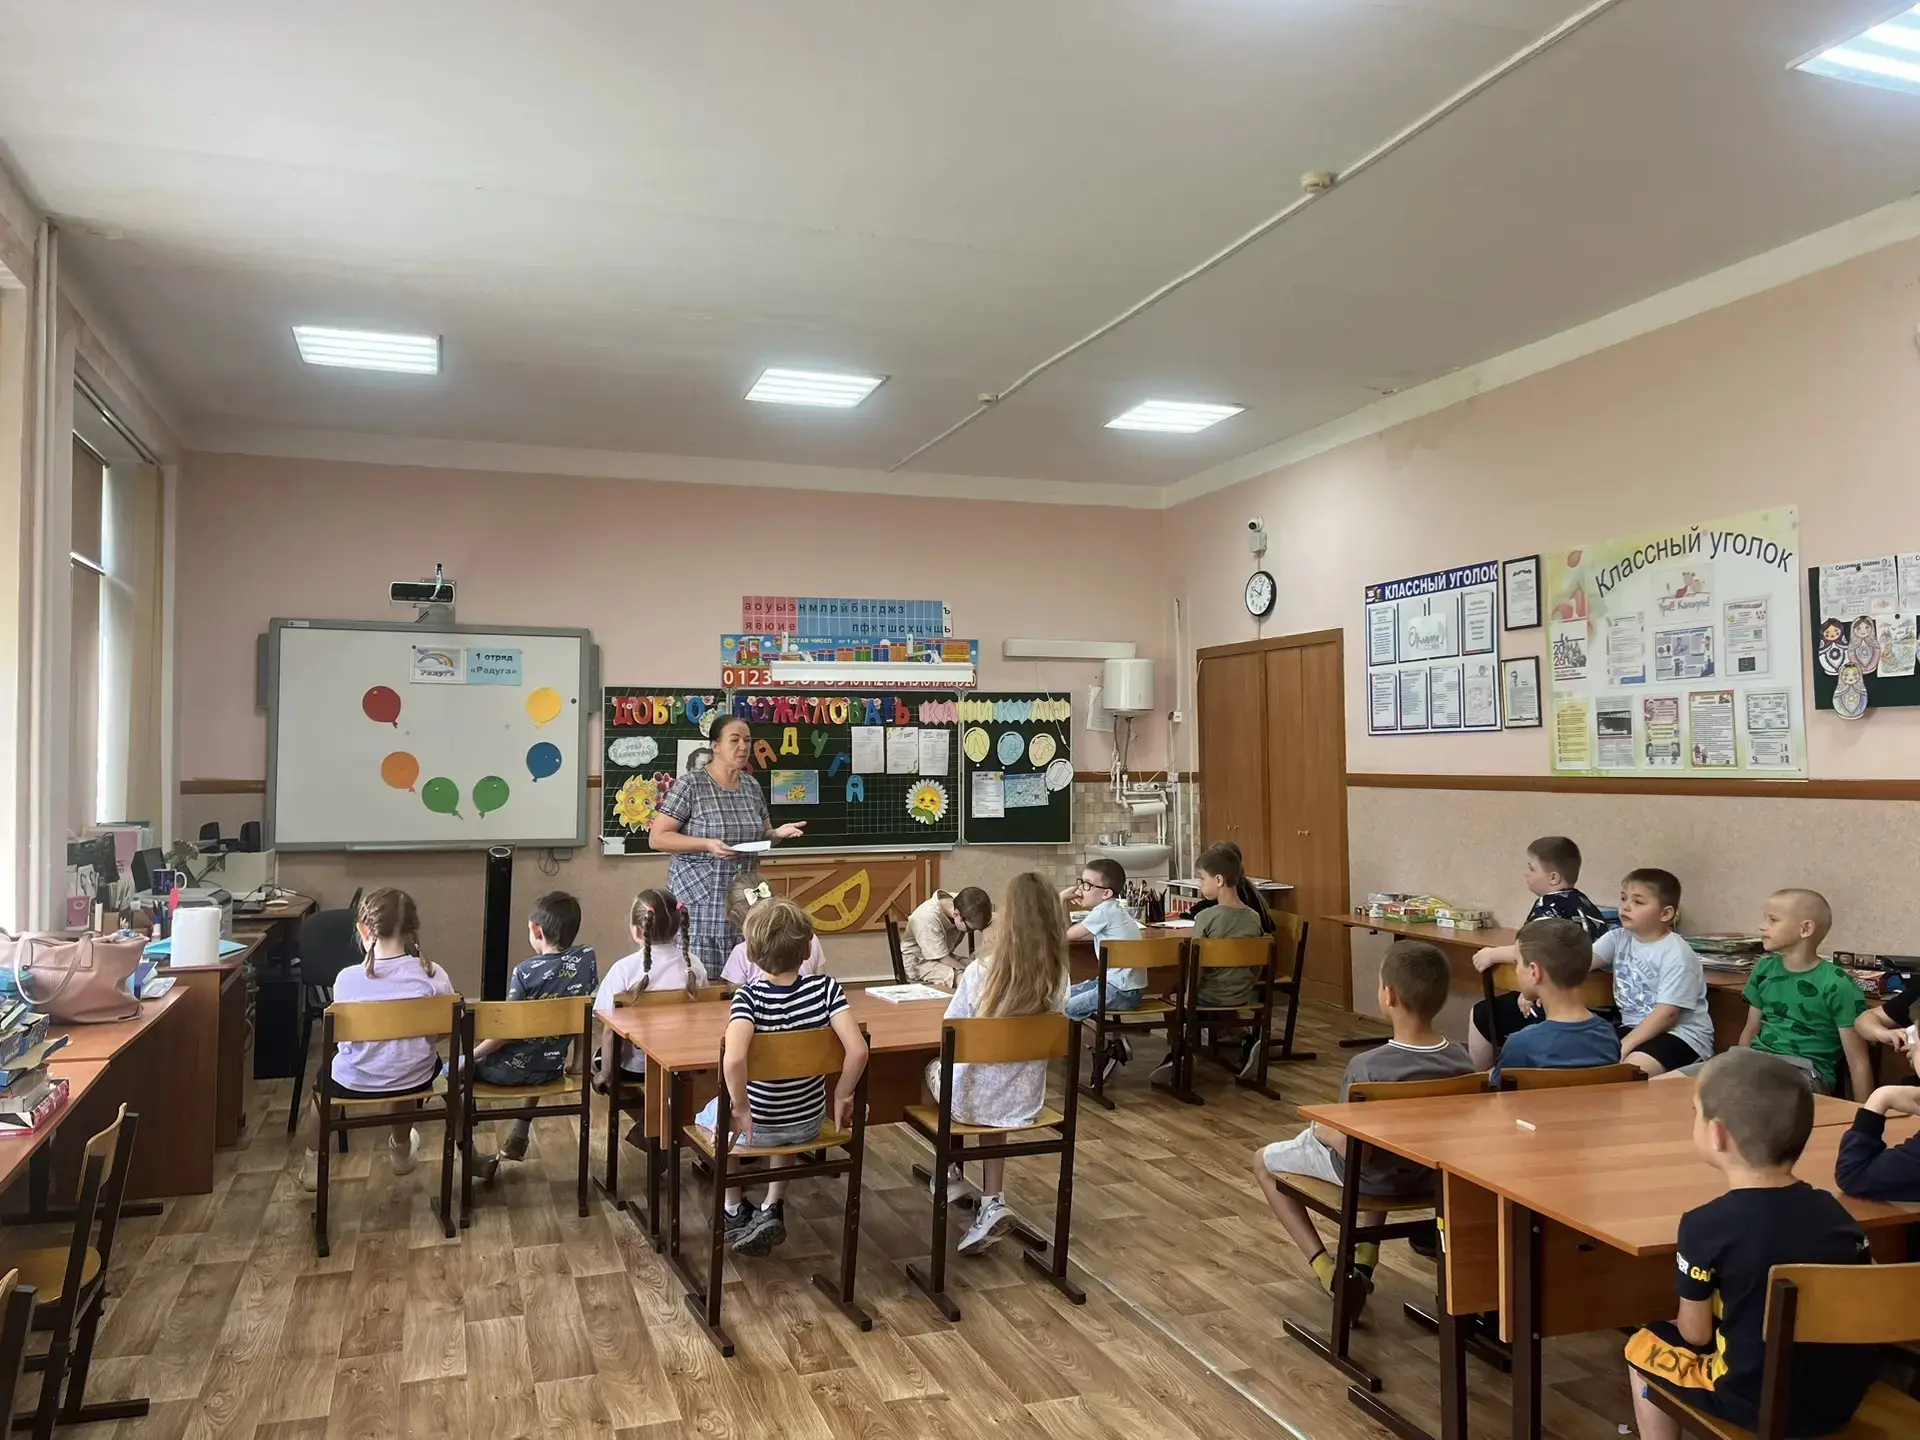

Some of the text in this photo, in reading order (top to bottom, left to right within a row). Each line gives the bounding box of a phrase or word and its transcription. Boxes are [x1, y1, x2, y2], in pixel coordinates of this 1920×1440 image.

[1594, 525, 1702, 598] Классный
[1710, 530, 1794, 573] уголок
[1384, 563, 1498, 600] КЛАССНЫЙ УГОЛОК
[470, 666, 517, 676] «Радуга»
[476, 652, 513, 662] 1 отряд
[612, 696, 911, 726] ДОБРО ПОЖАЛОВАТЬ
[750, 727, 864, 802] АДУГА
